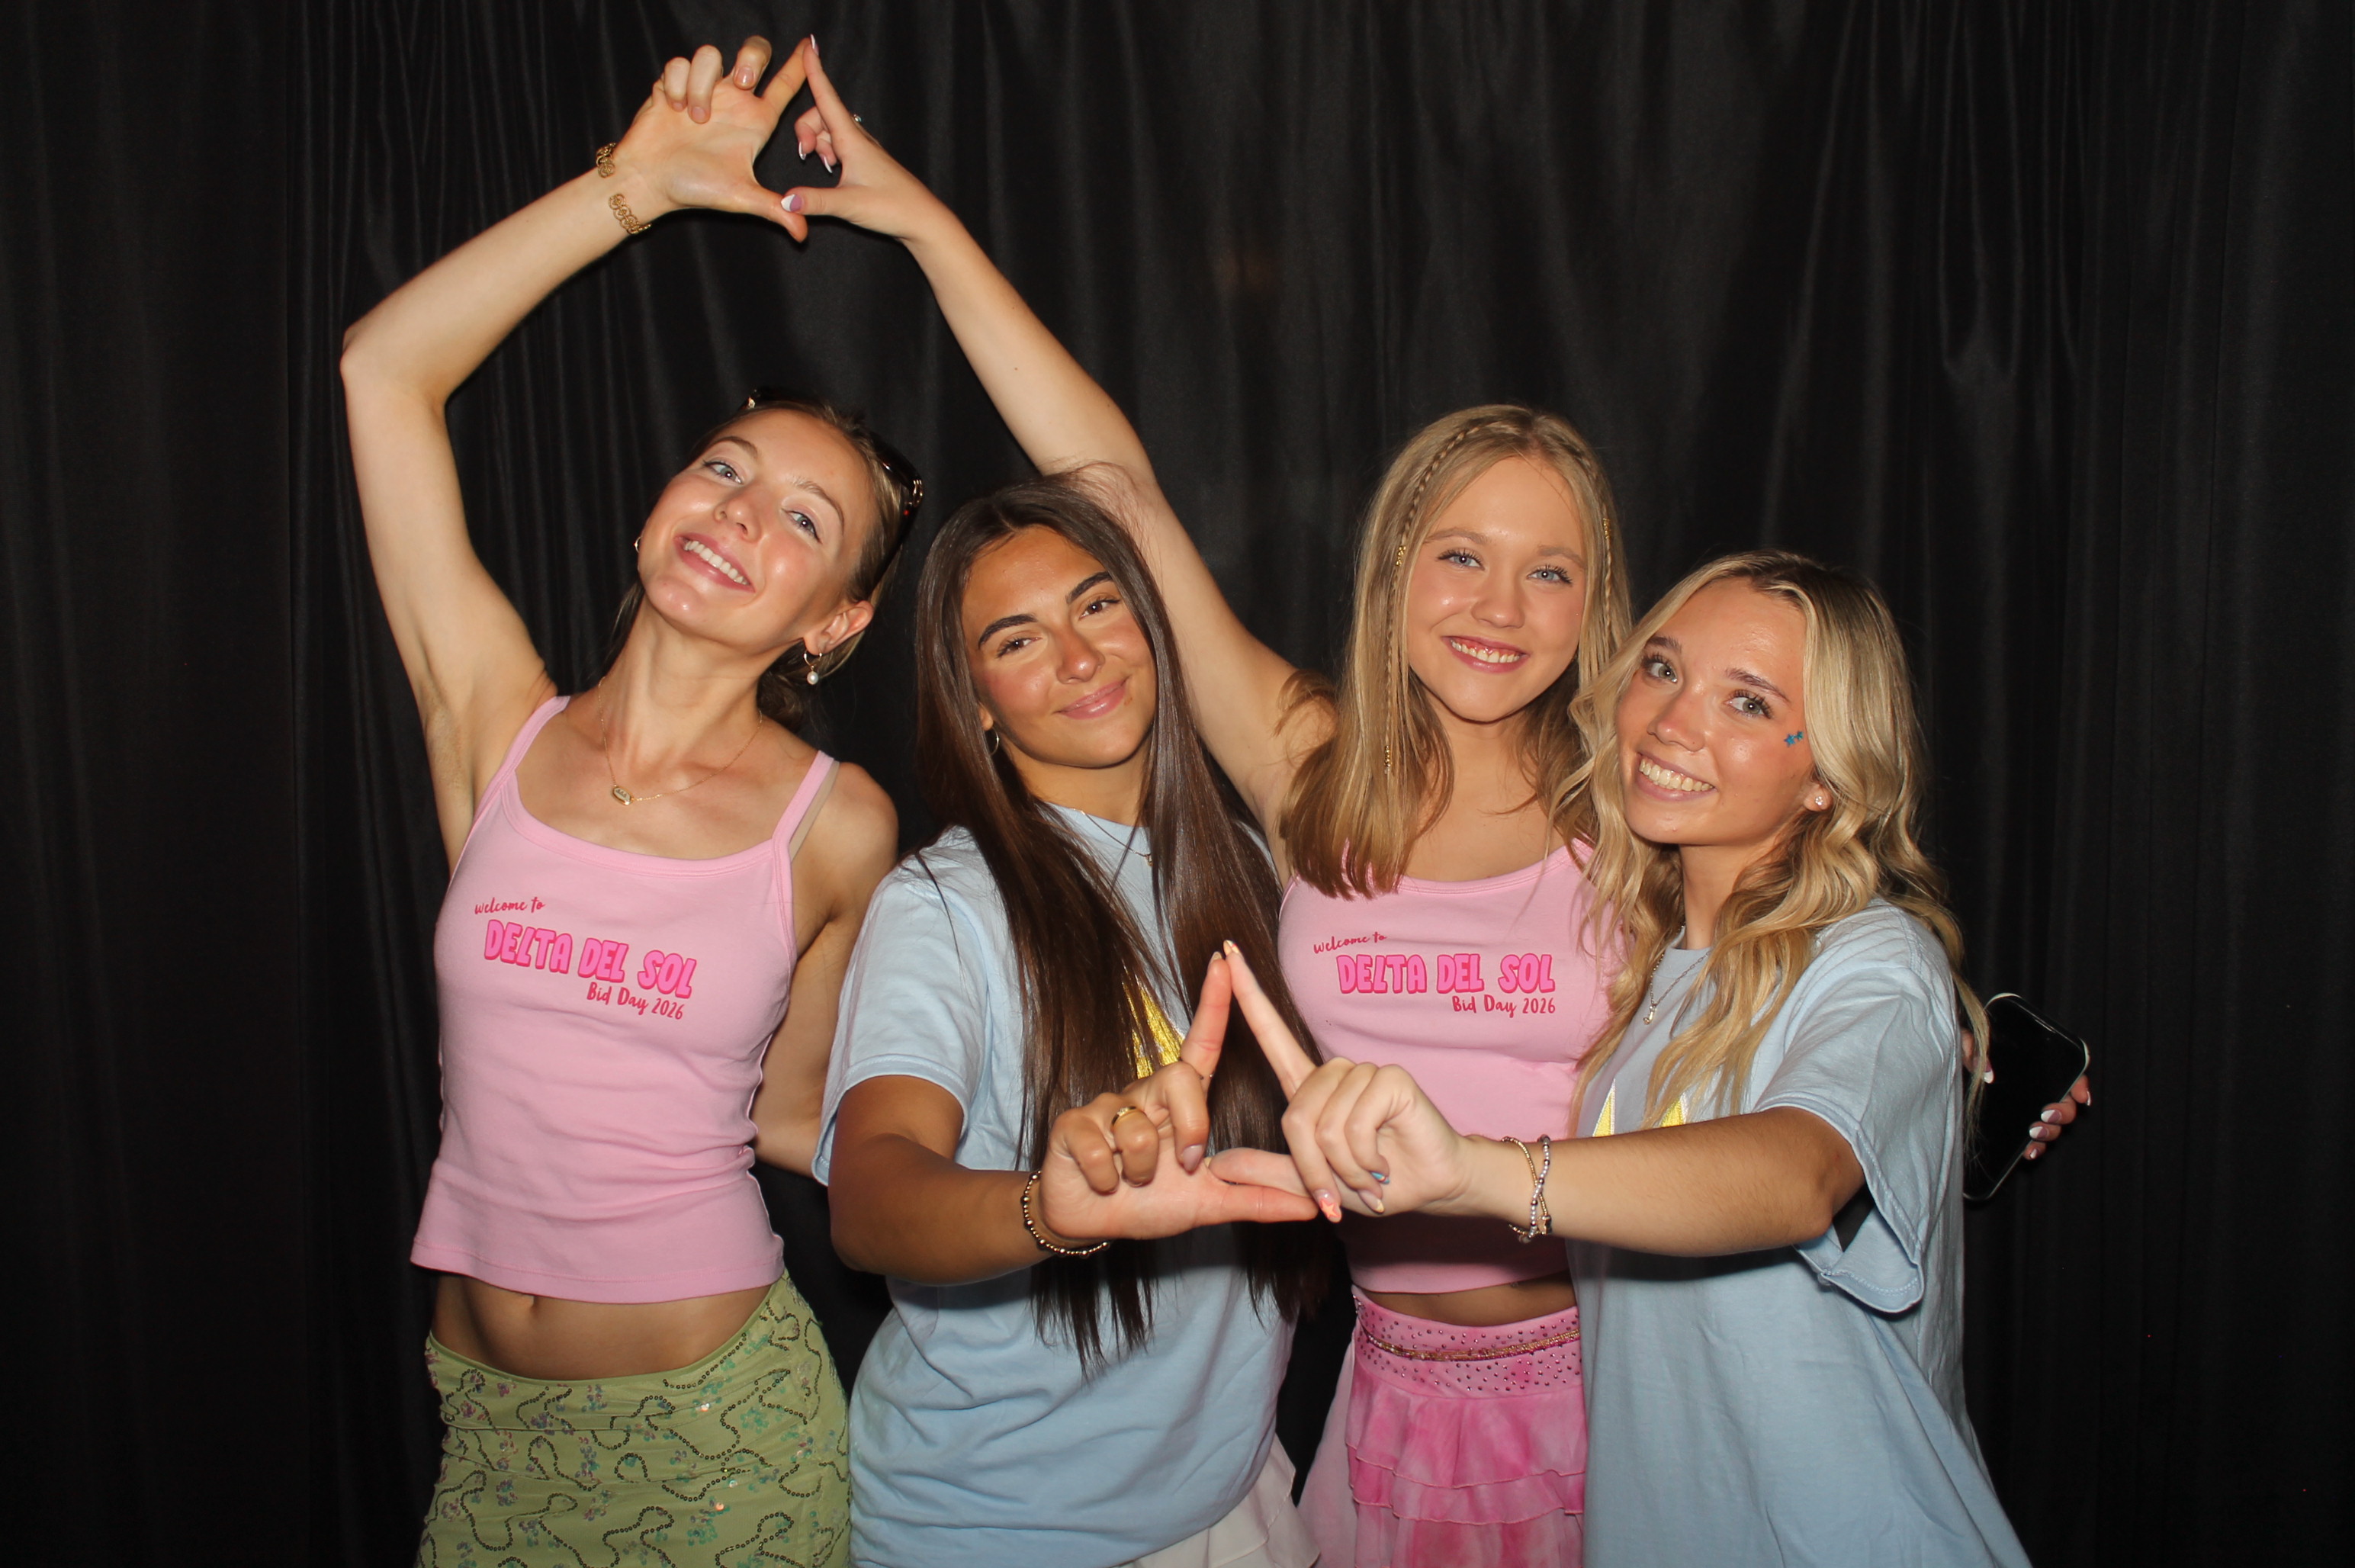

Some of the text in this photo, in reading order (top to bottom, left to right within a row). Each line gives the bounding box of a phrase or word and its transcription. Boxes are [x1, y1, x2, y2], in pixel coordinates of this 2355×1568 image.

[475, 897, 546, 914] welcome to
[484, 919, 697, 999] DELTA DEL SOL
[1313, 932, 1388, 955] welcome to
[1335, 953, 1557, 994] DELTA DEL SOL
[586, 982, 686, 1020] Bid Day 2026
[1451, 994, 1557, 1019] Bid Day 2026
